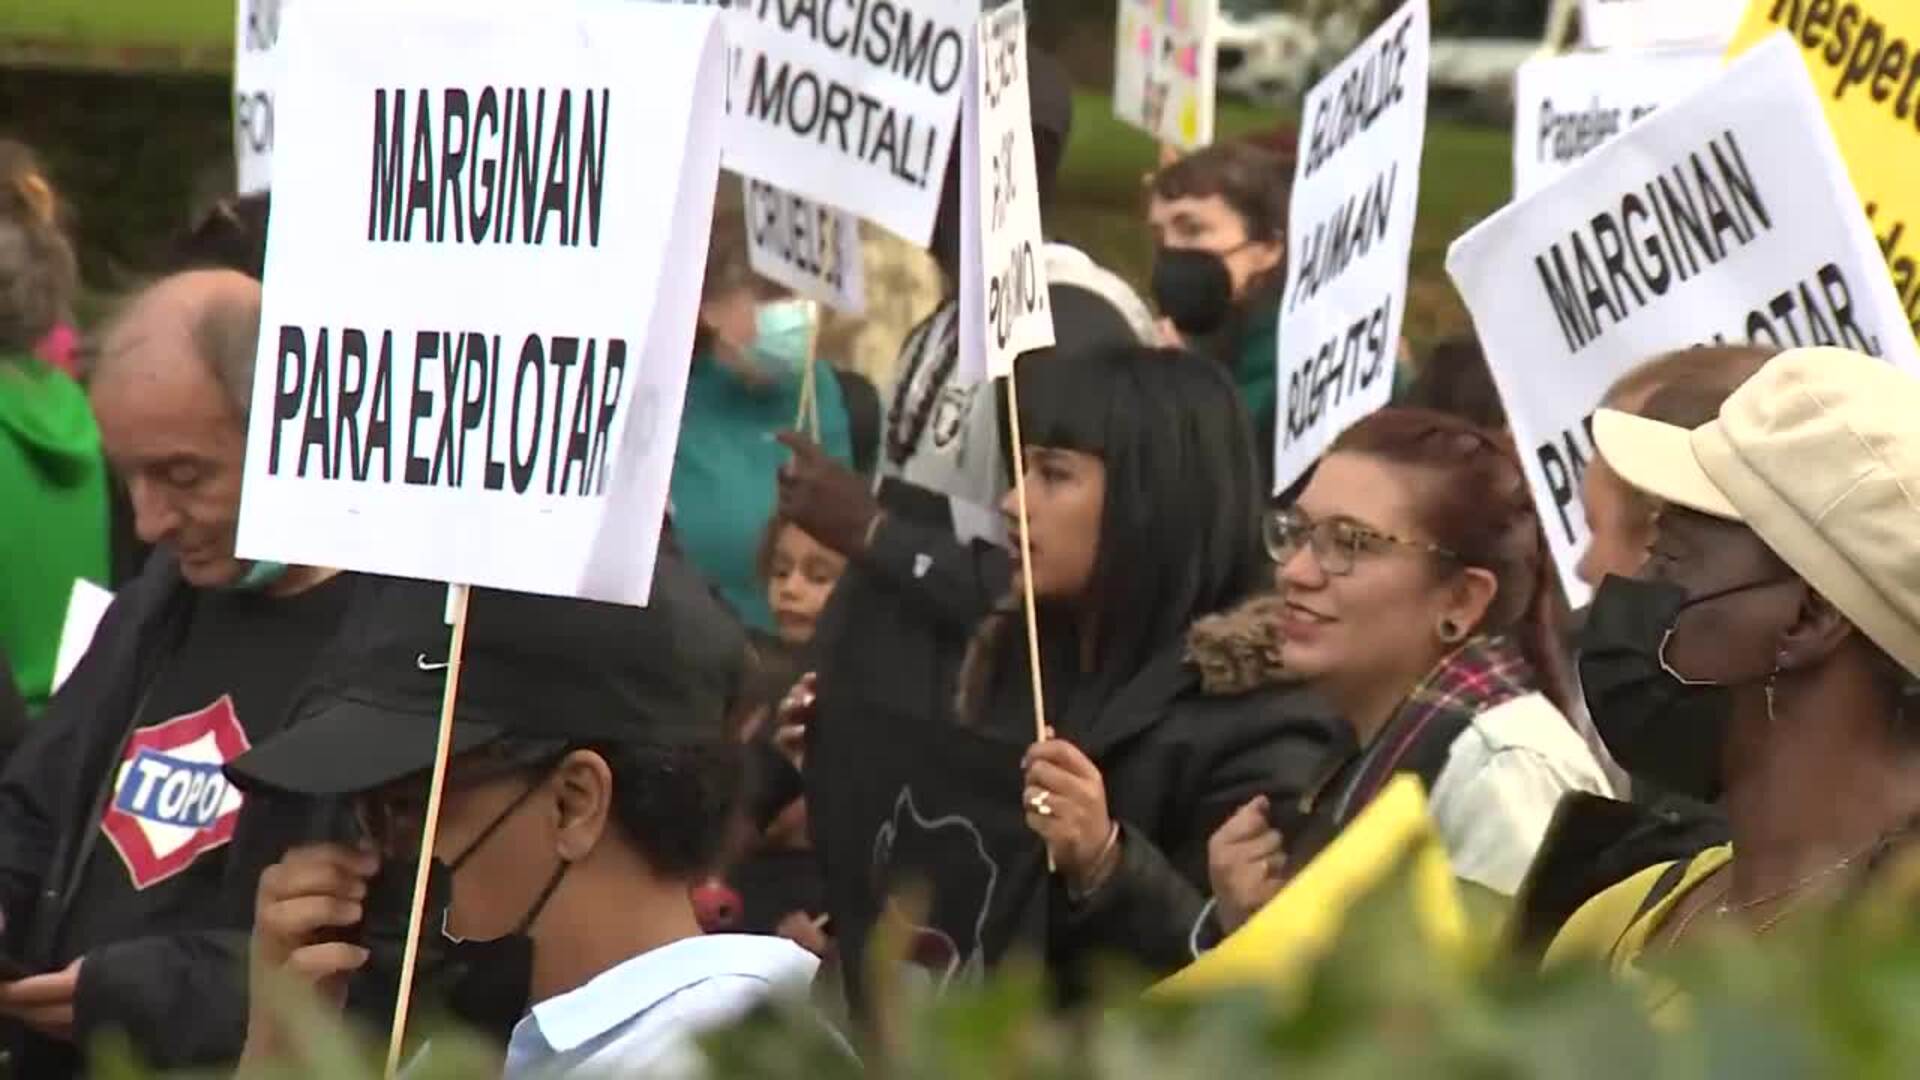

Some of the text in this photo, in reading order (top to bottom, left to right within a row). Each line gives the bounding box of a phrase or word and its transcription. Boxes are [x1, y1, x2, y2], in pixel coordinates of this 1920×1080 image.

[368, 86, 610, 247] MARGINAN
[745, 52, 937, 189] MORTAL!
[1290, 161, 1396, 313] HUMAN
[1535, 130, 1772, 354] MARGINAN
[268, 326, 393, 484] PARA
[1284, 292, 1391, 450] RIGHTS!
[131, 757, 225, 824] TOPO
